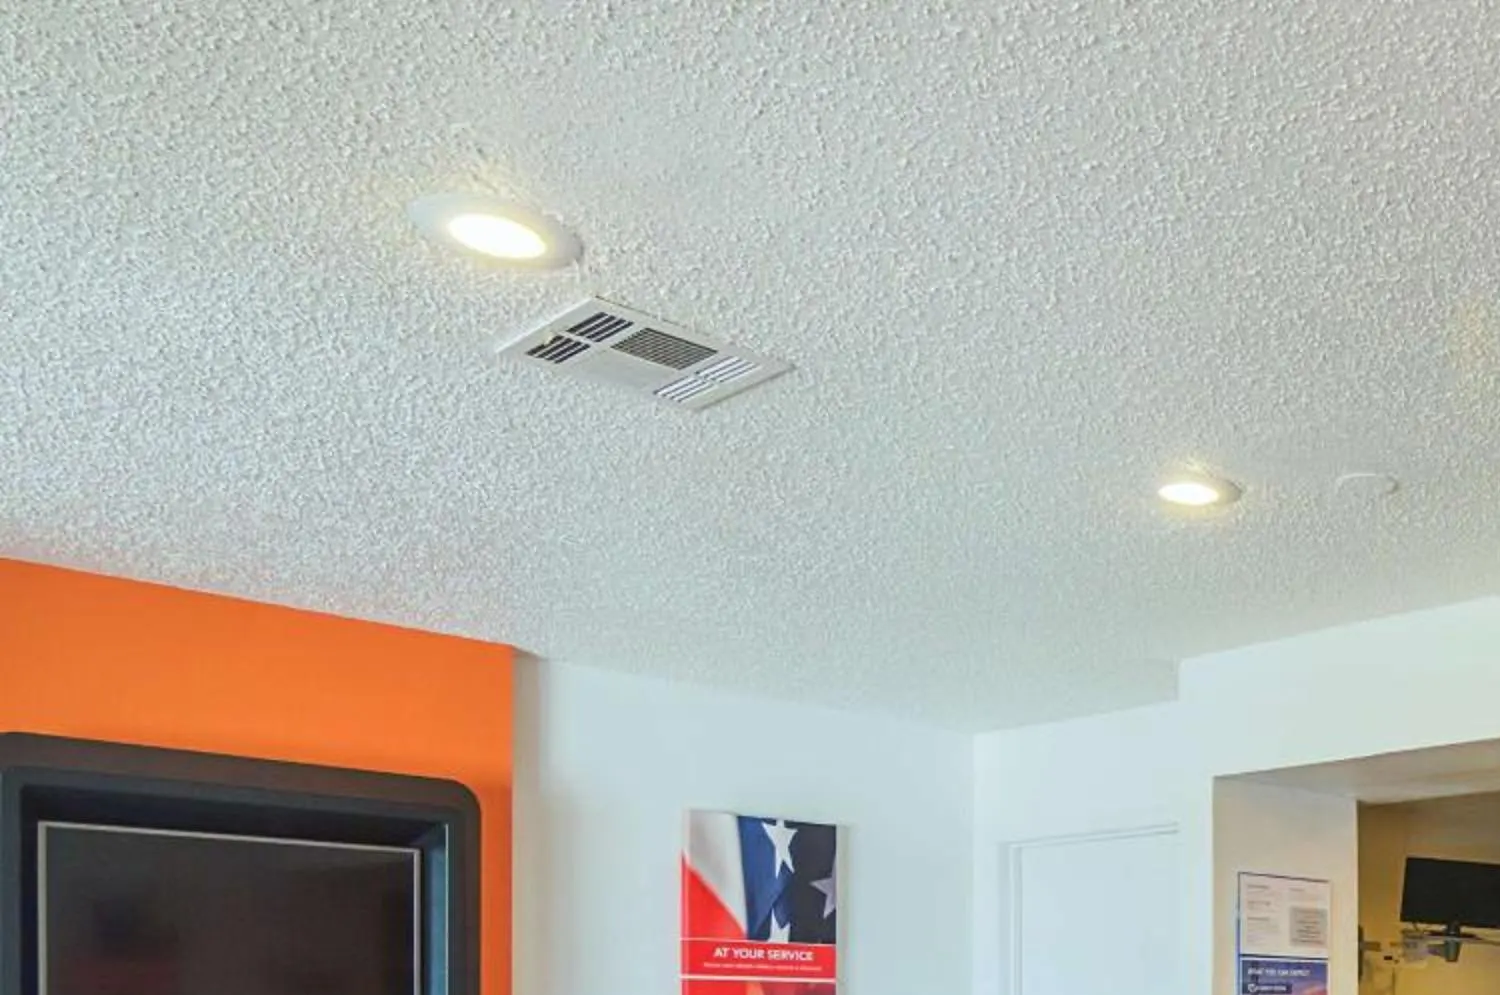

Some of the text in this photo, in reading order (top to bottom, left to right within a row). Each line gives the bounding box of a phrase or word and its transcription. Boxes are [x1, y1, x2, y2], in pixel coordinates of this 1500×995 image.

[713, 947, 814, 961] AT YOUR SERVICE
